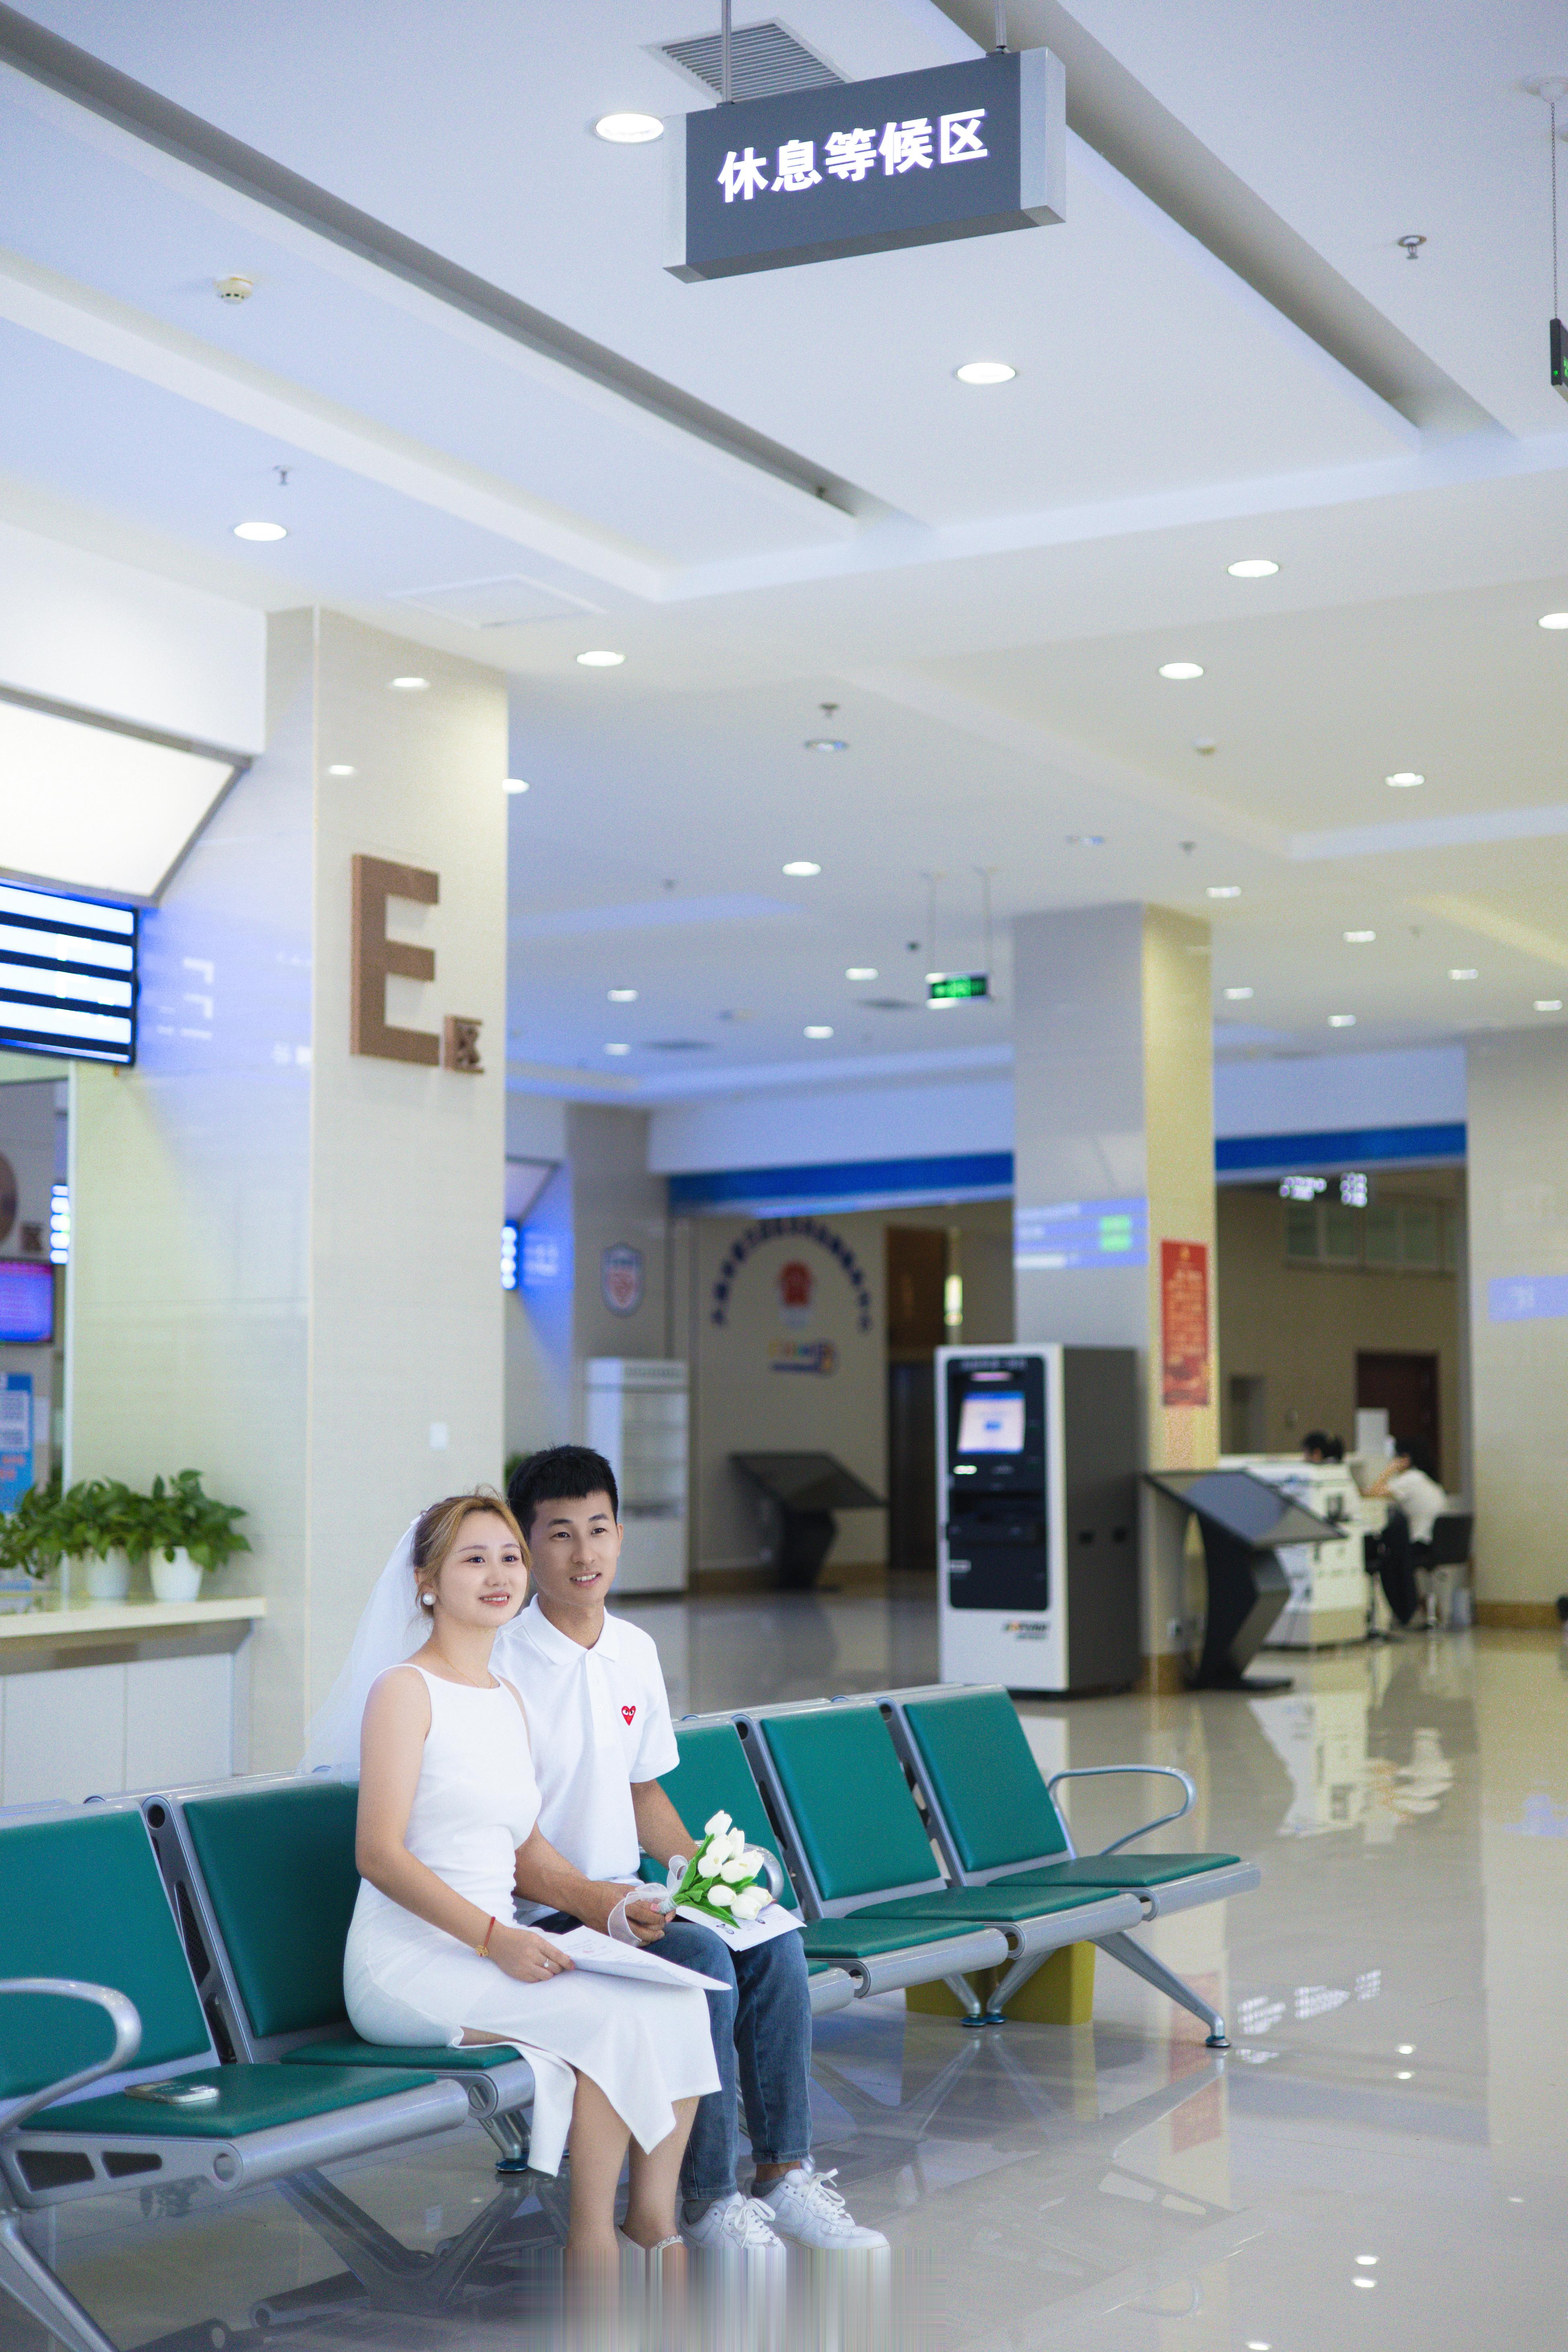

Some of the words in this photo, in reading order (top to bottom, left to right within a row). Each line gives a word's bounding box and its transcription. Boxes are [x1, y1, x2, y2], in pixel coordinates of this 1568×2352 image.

[717, 109, 988, 203] 休息等候区
